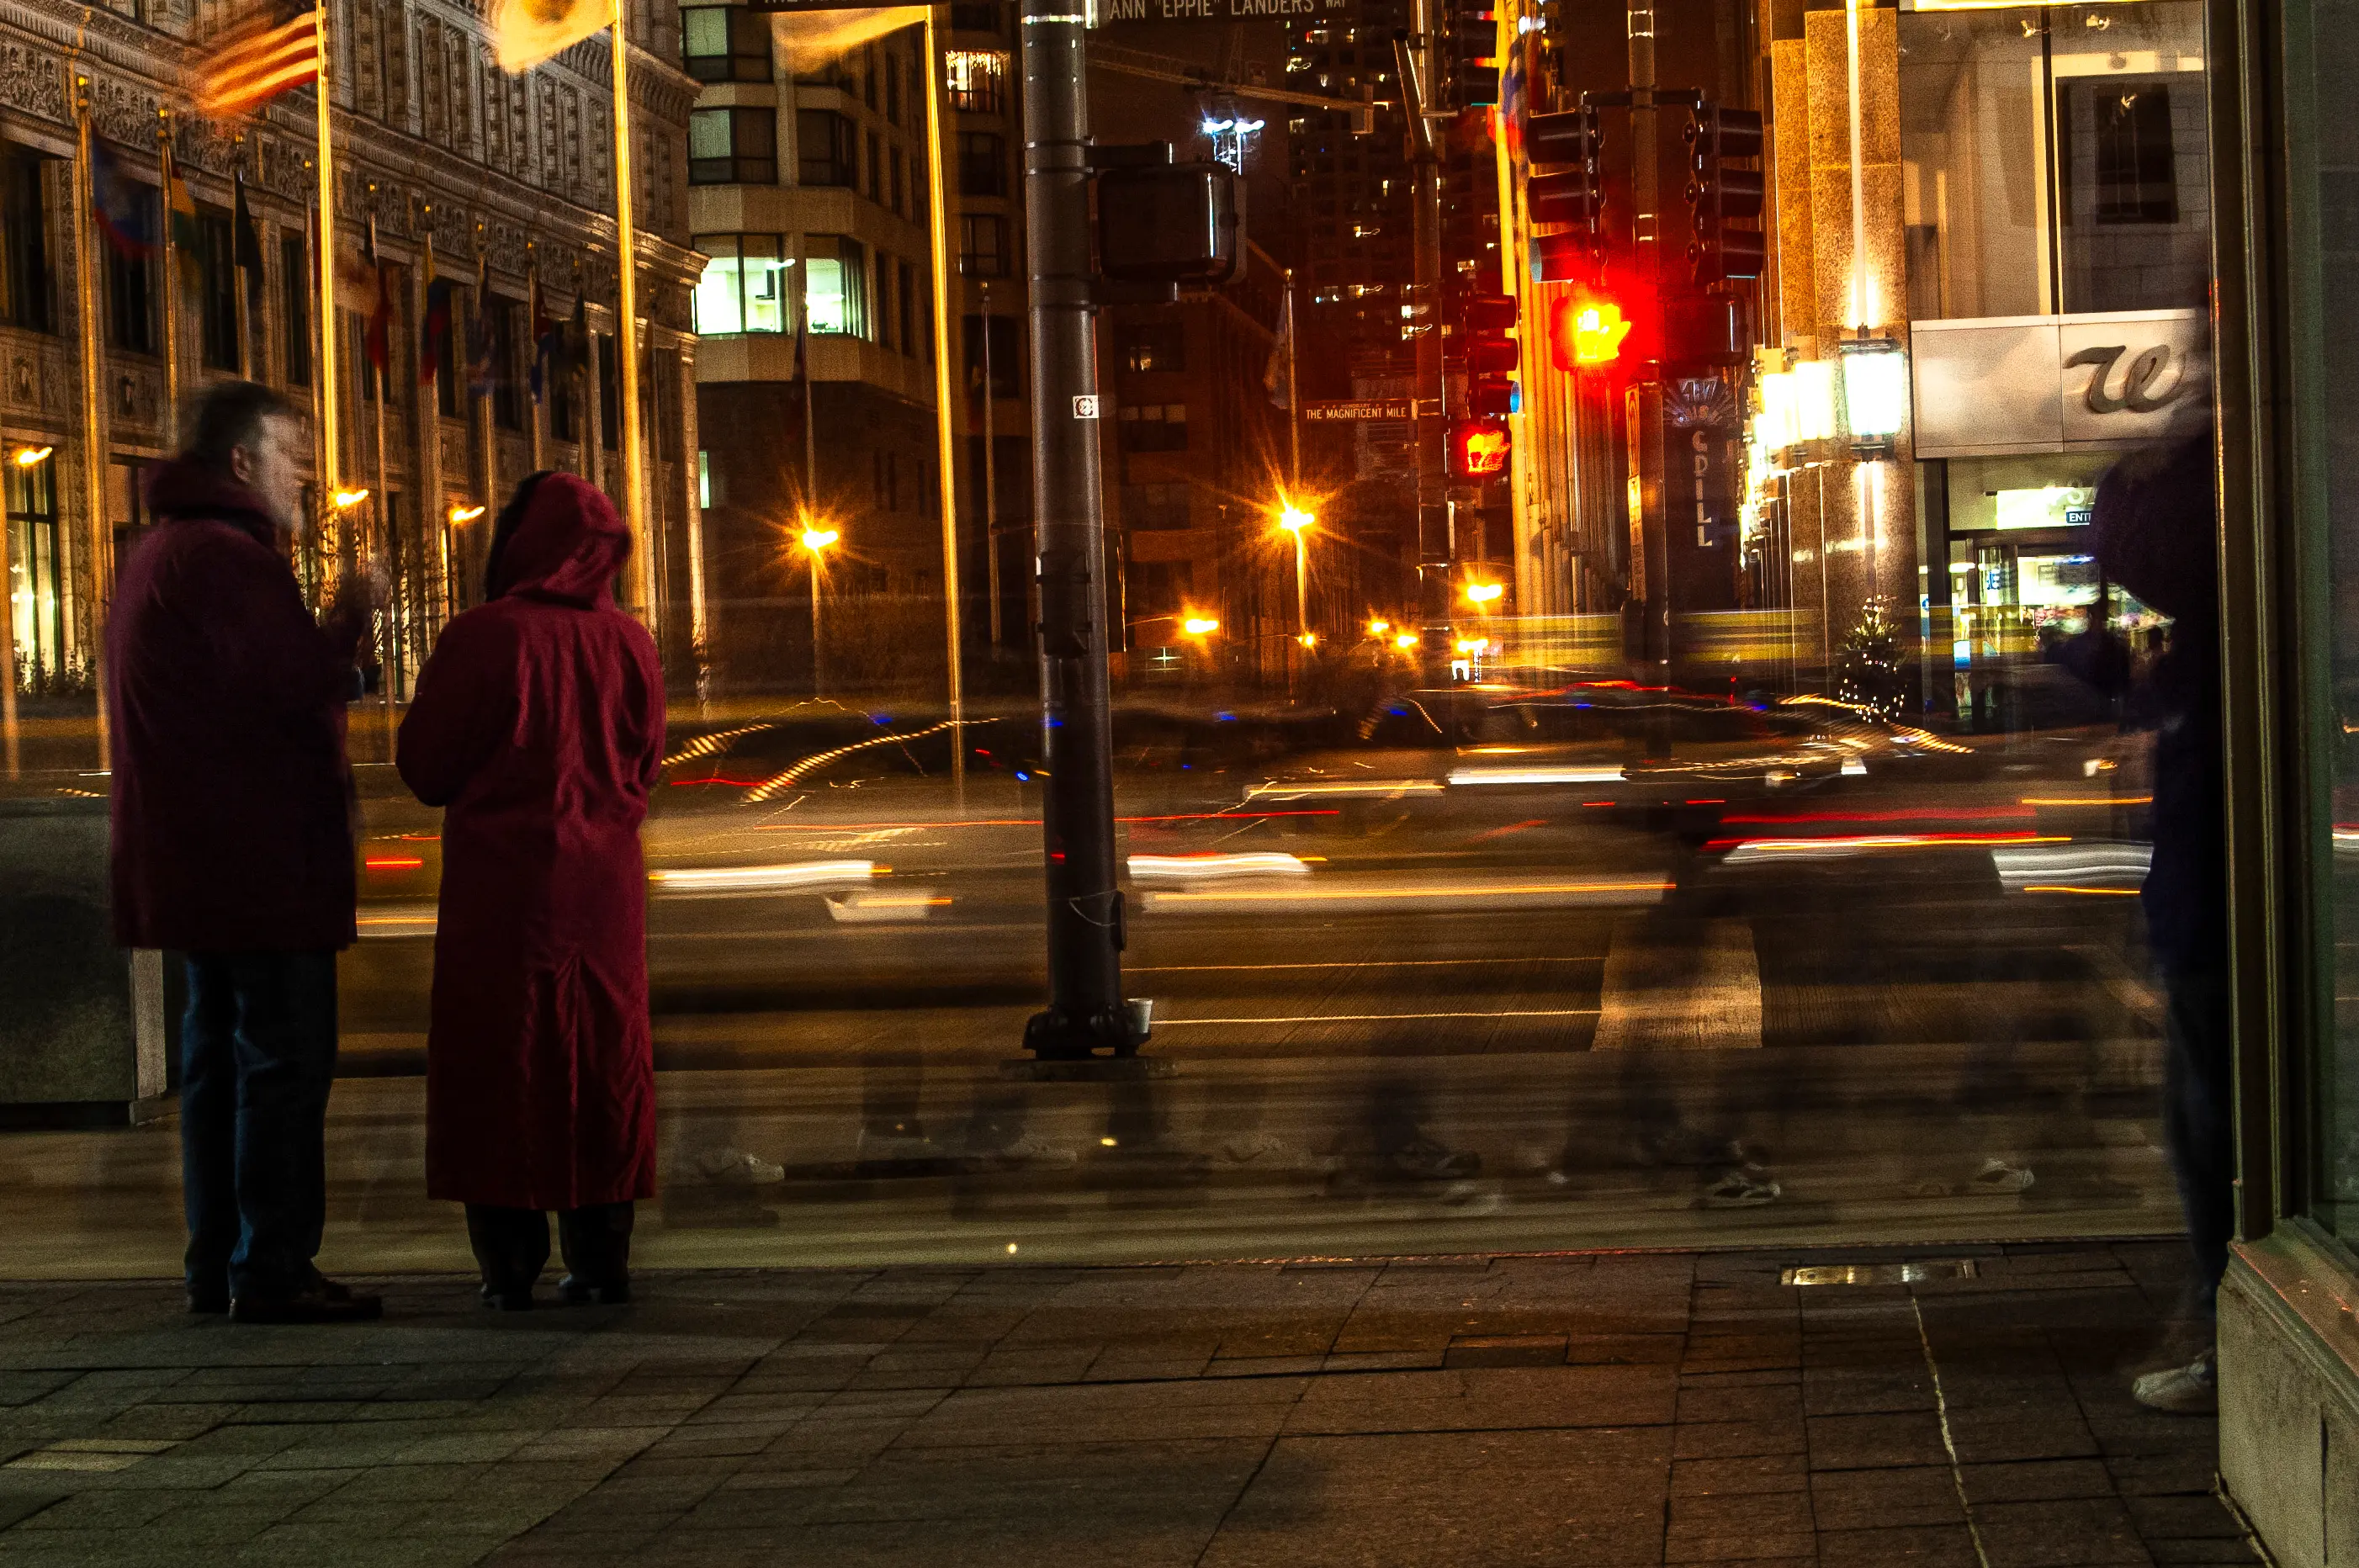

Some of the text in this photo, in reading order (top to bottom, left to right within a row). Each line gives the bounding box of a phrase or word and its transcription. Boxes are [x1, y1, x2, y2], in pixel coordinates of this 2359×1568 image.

[1110, 0, 1146, 19] ANN
[1231, 0, 1314, 15] LANDERS
[1306, 406, 1407, 420] THE MAGNIFICENT MILE
[2069, 511, 2092, 522] ENT
